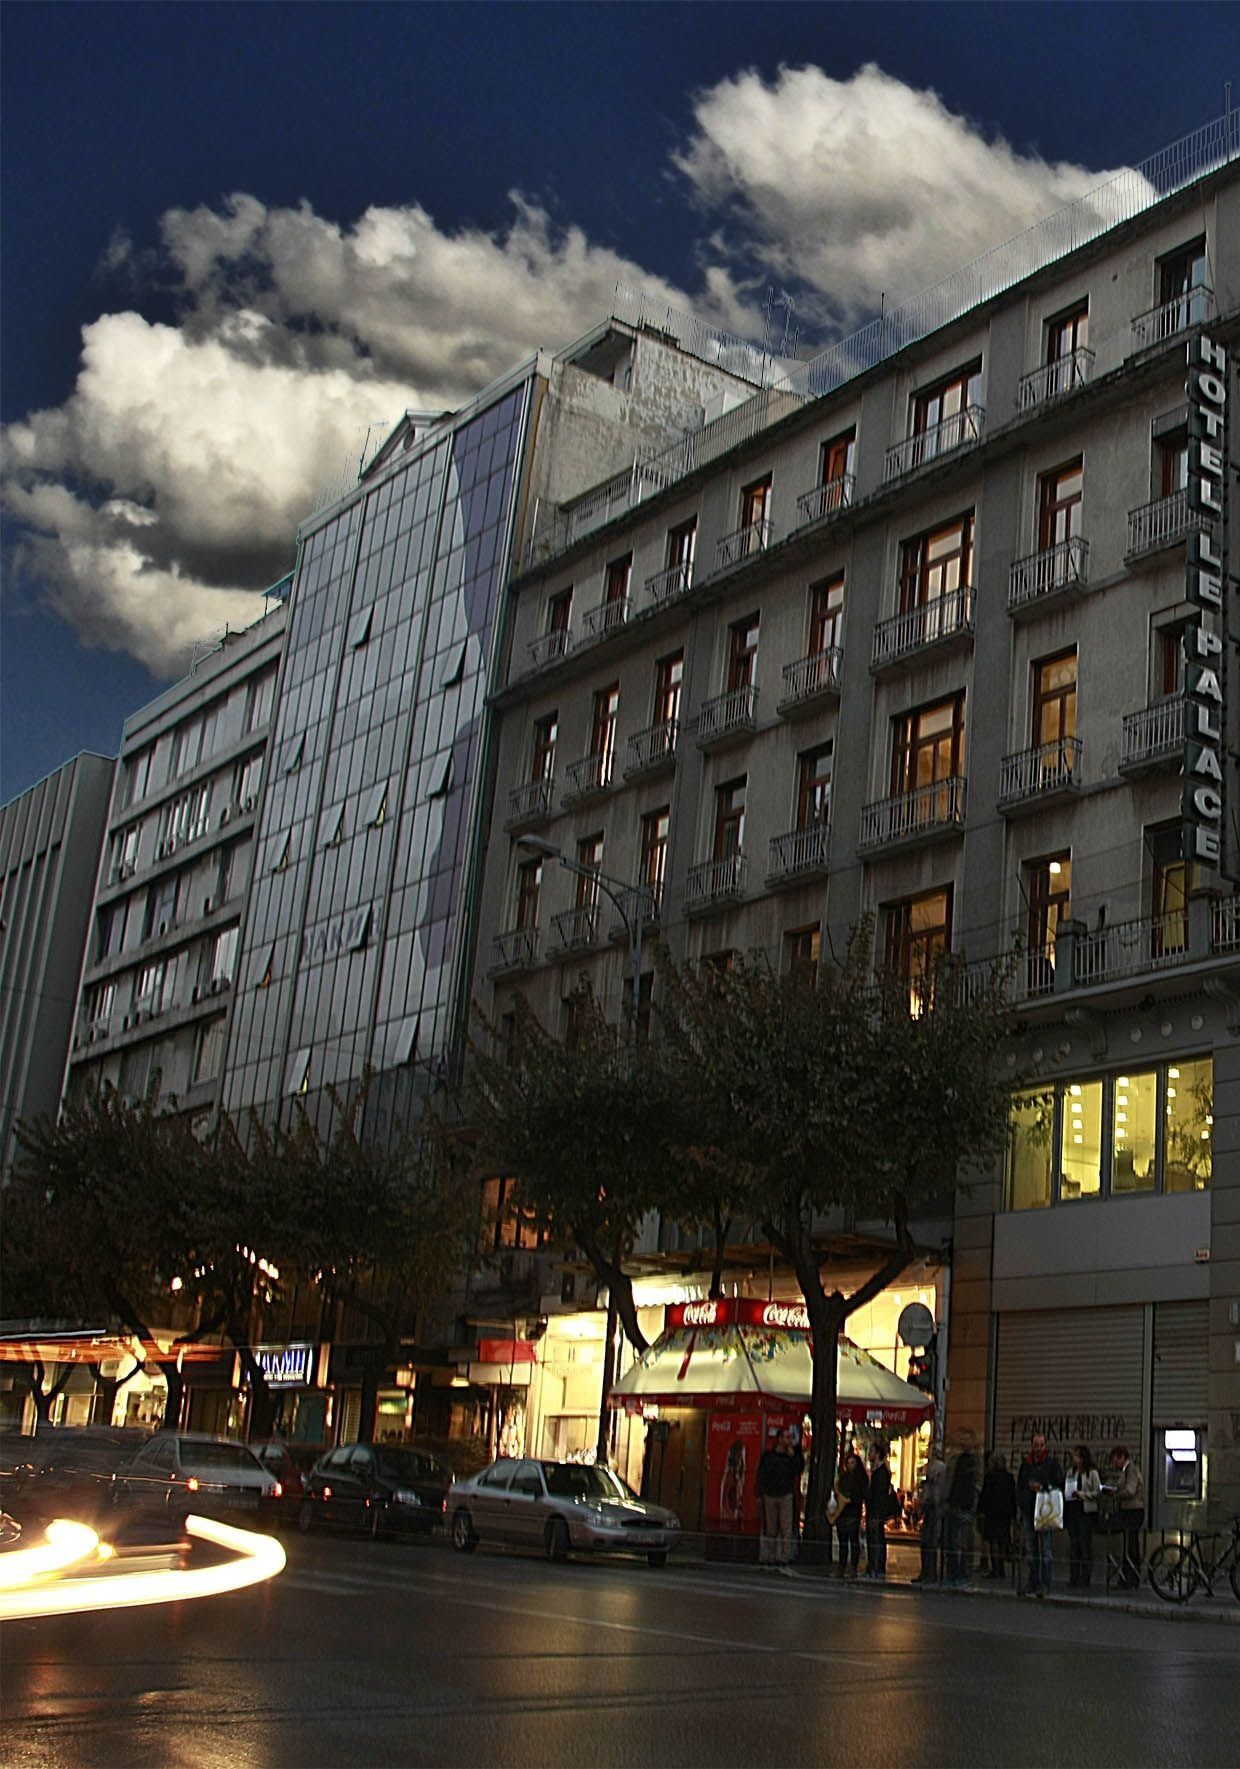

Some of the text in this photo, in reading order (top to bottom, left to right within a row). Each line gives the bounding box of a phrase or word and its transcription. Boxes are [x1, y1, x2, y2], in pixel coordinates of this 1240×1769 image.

[1194, 335, 1226, 861] HOTEL LE PALACE
